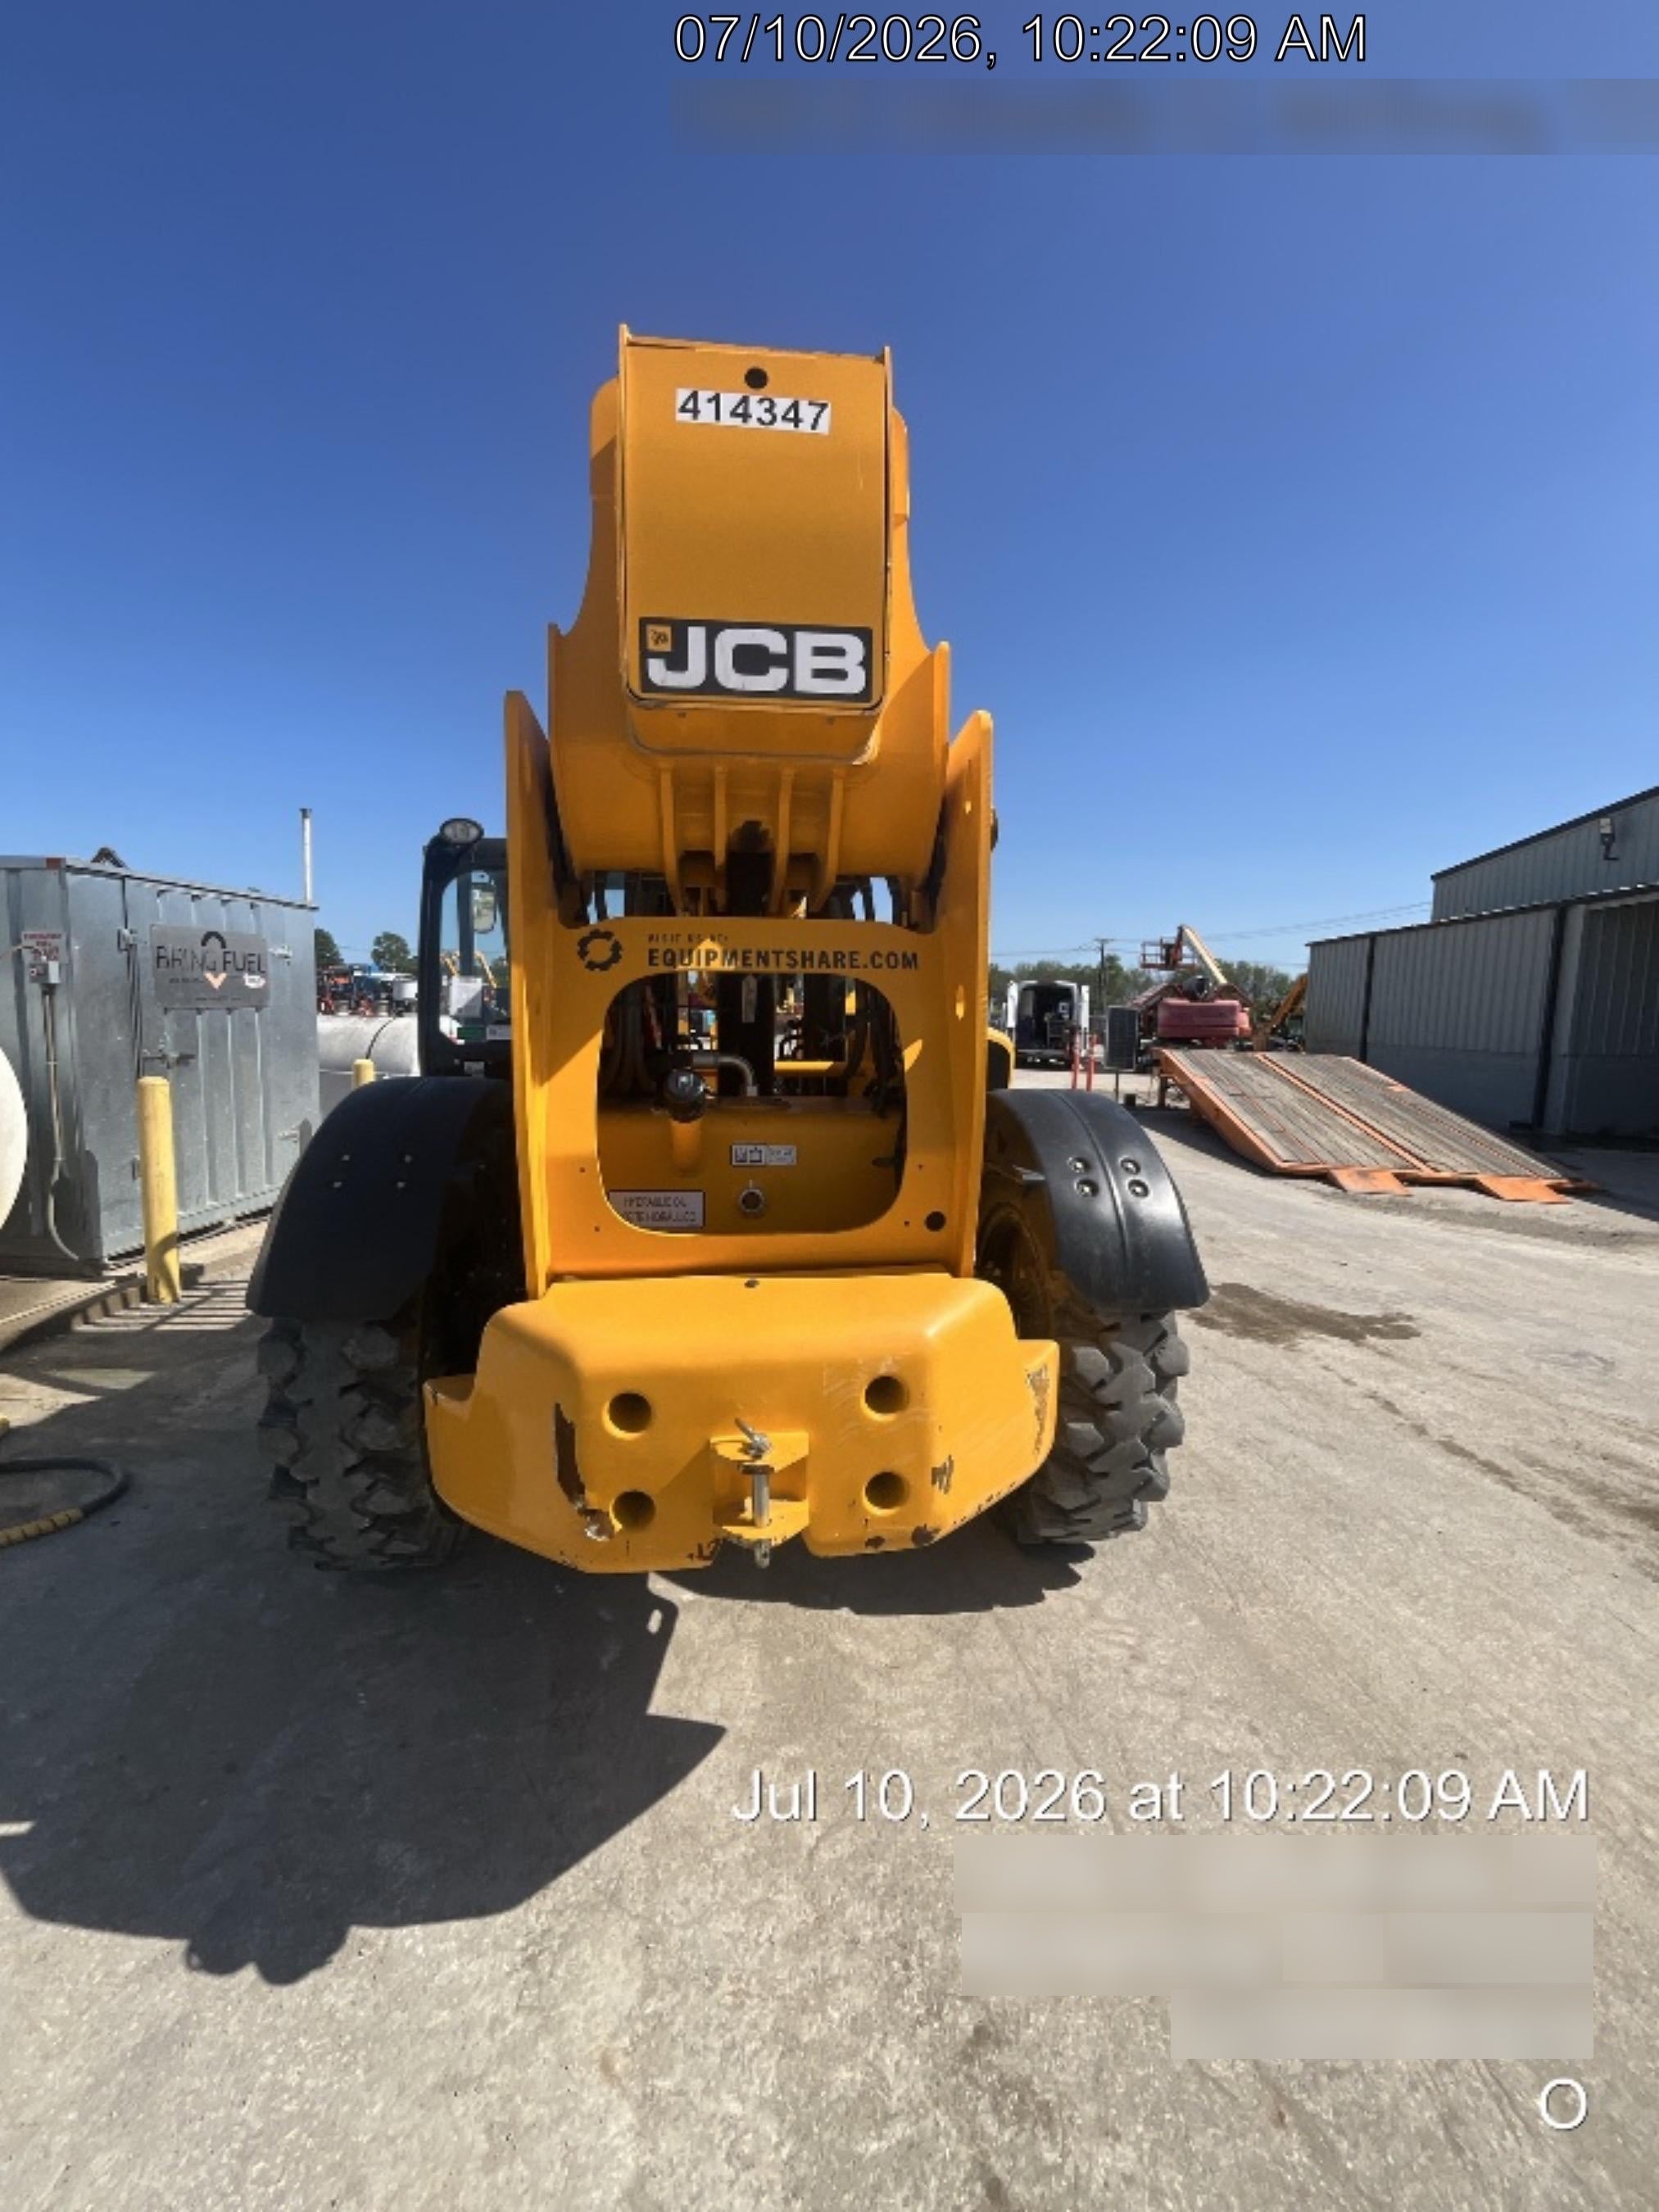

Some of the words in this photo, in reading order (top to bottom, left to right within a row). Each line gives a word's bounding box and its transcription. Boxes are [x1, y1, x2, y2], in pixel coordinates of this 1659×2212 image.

[678, 390, 829, 431] 414347
[646, 625, 867, 695] JCB
[223, 950, 266, 974] FUEL
[647, 948, 918, 970] EQUIPMENTSHARE.COM
